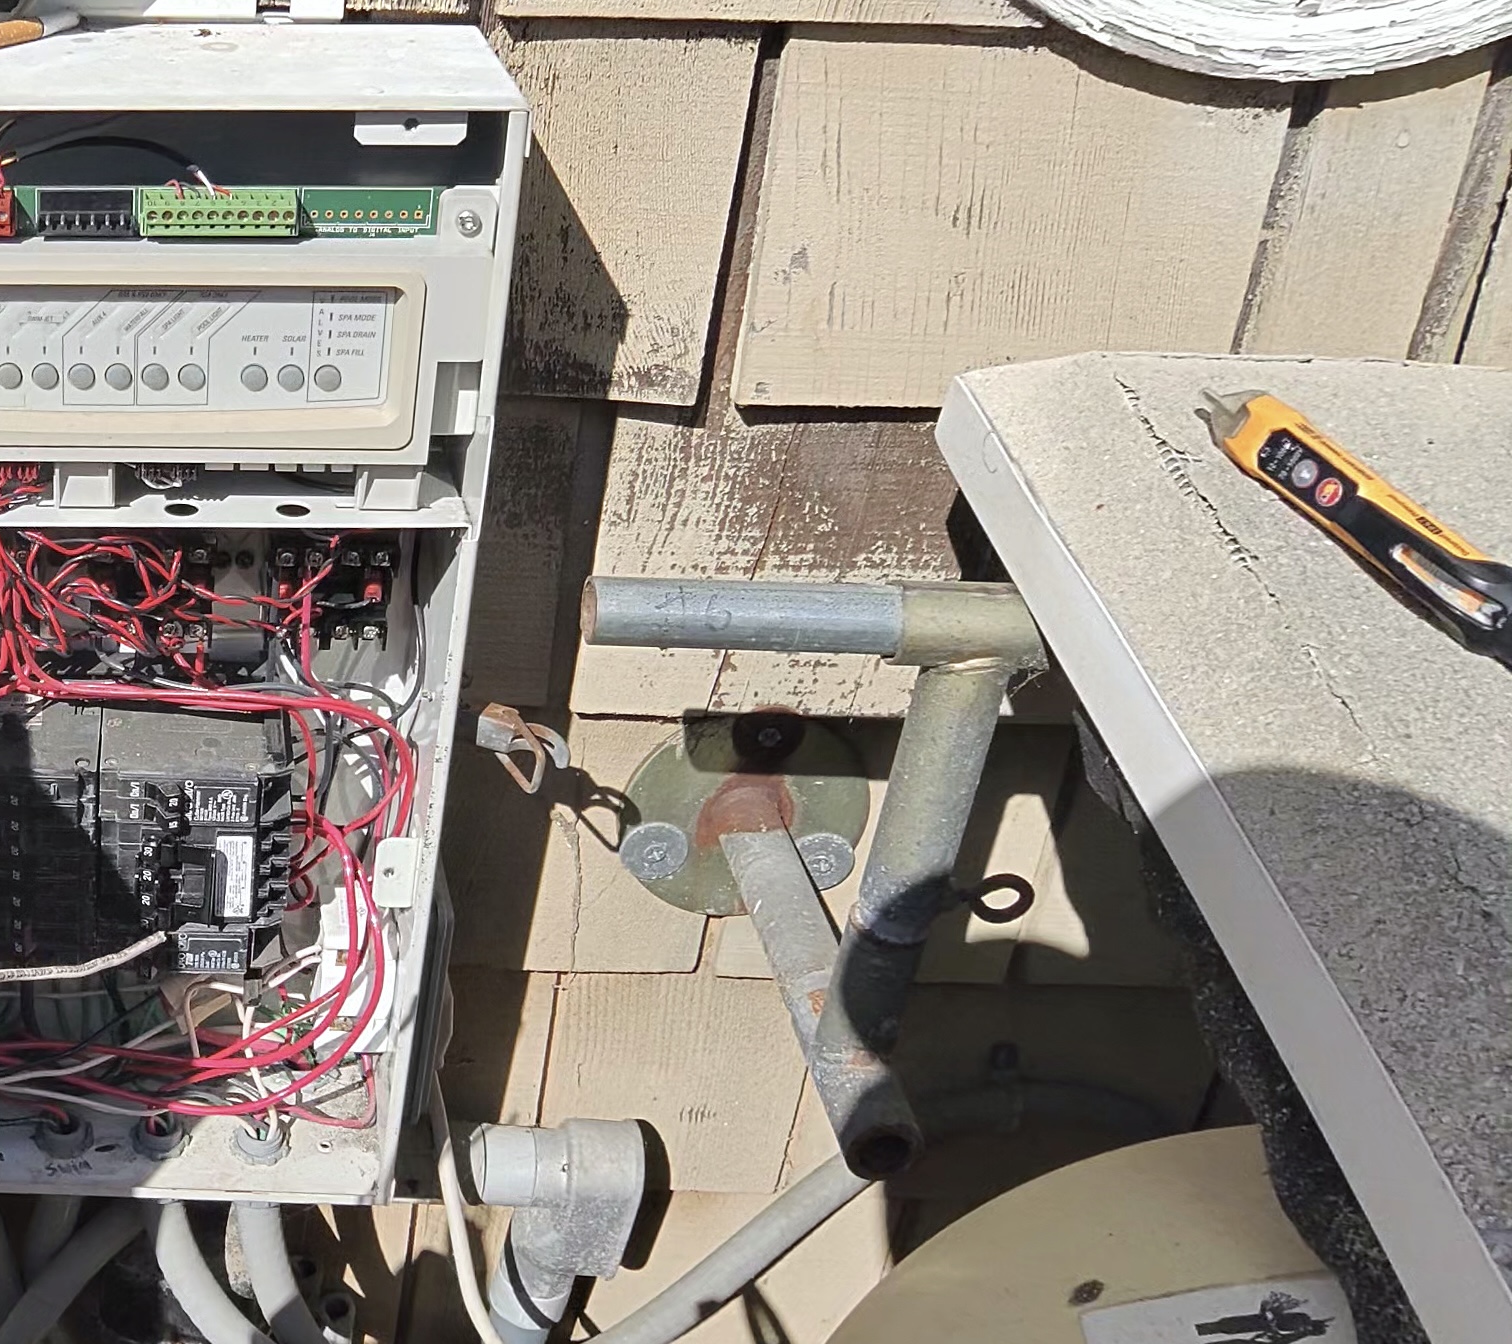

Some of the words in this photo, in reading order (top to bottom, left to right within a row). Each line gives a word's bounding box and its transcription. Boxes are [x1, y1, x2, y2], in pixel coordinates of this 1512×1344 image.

[337, 314, 353, 322] SPA
[353, 314, 376, 322] MODE
[336, 331, 352, 339] SPA
[352, 331, 376, 339] DRAIN
[335, 349, 351, 357] SPA
[168, 798, 179, 807] 20
[168, 820, 178, 829] 15
[143, 846, 153, 857] 30
[142, 869, 153, 881] 20
[141, 894, 151, 906] 20
